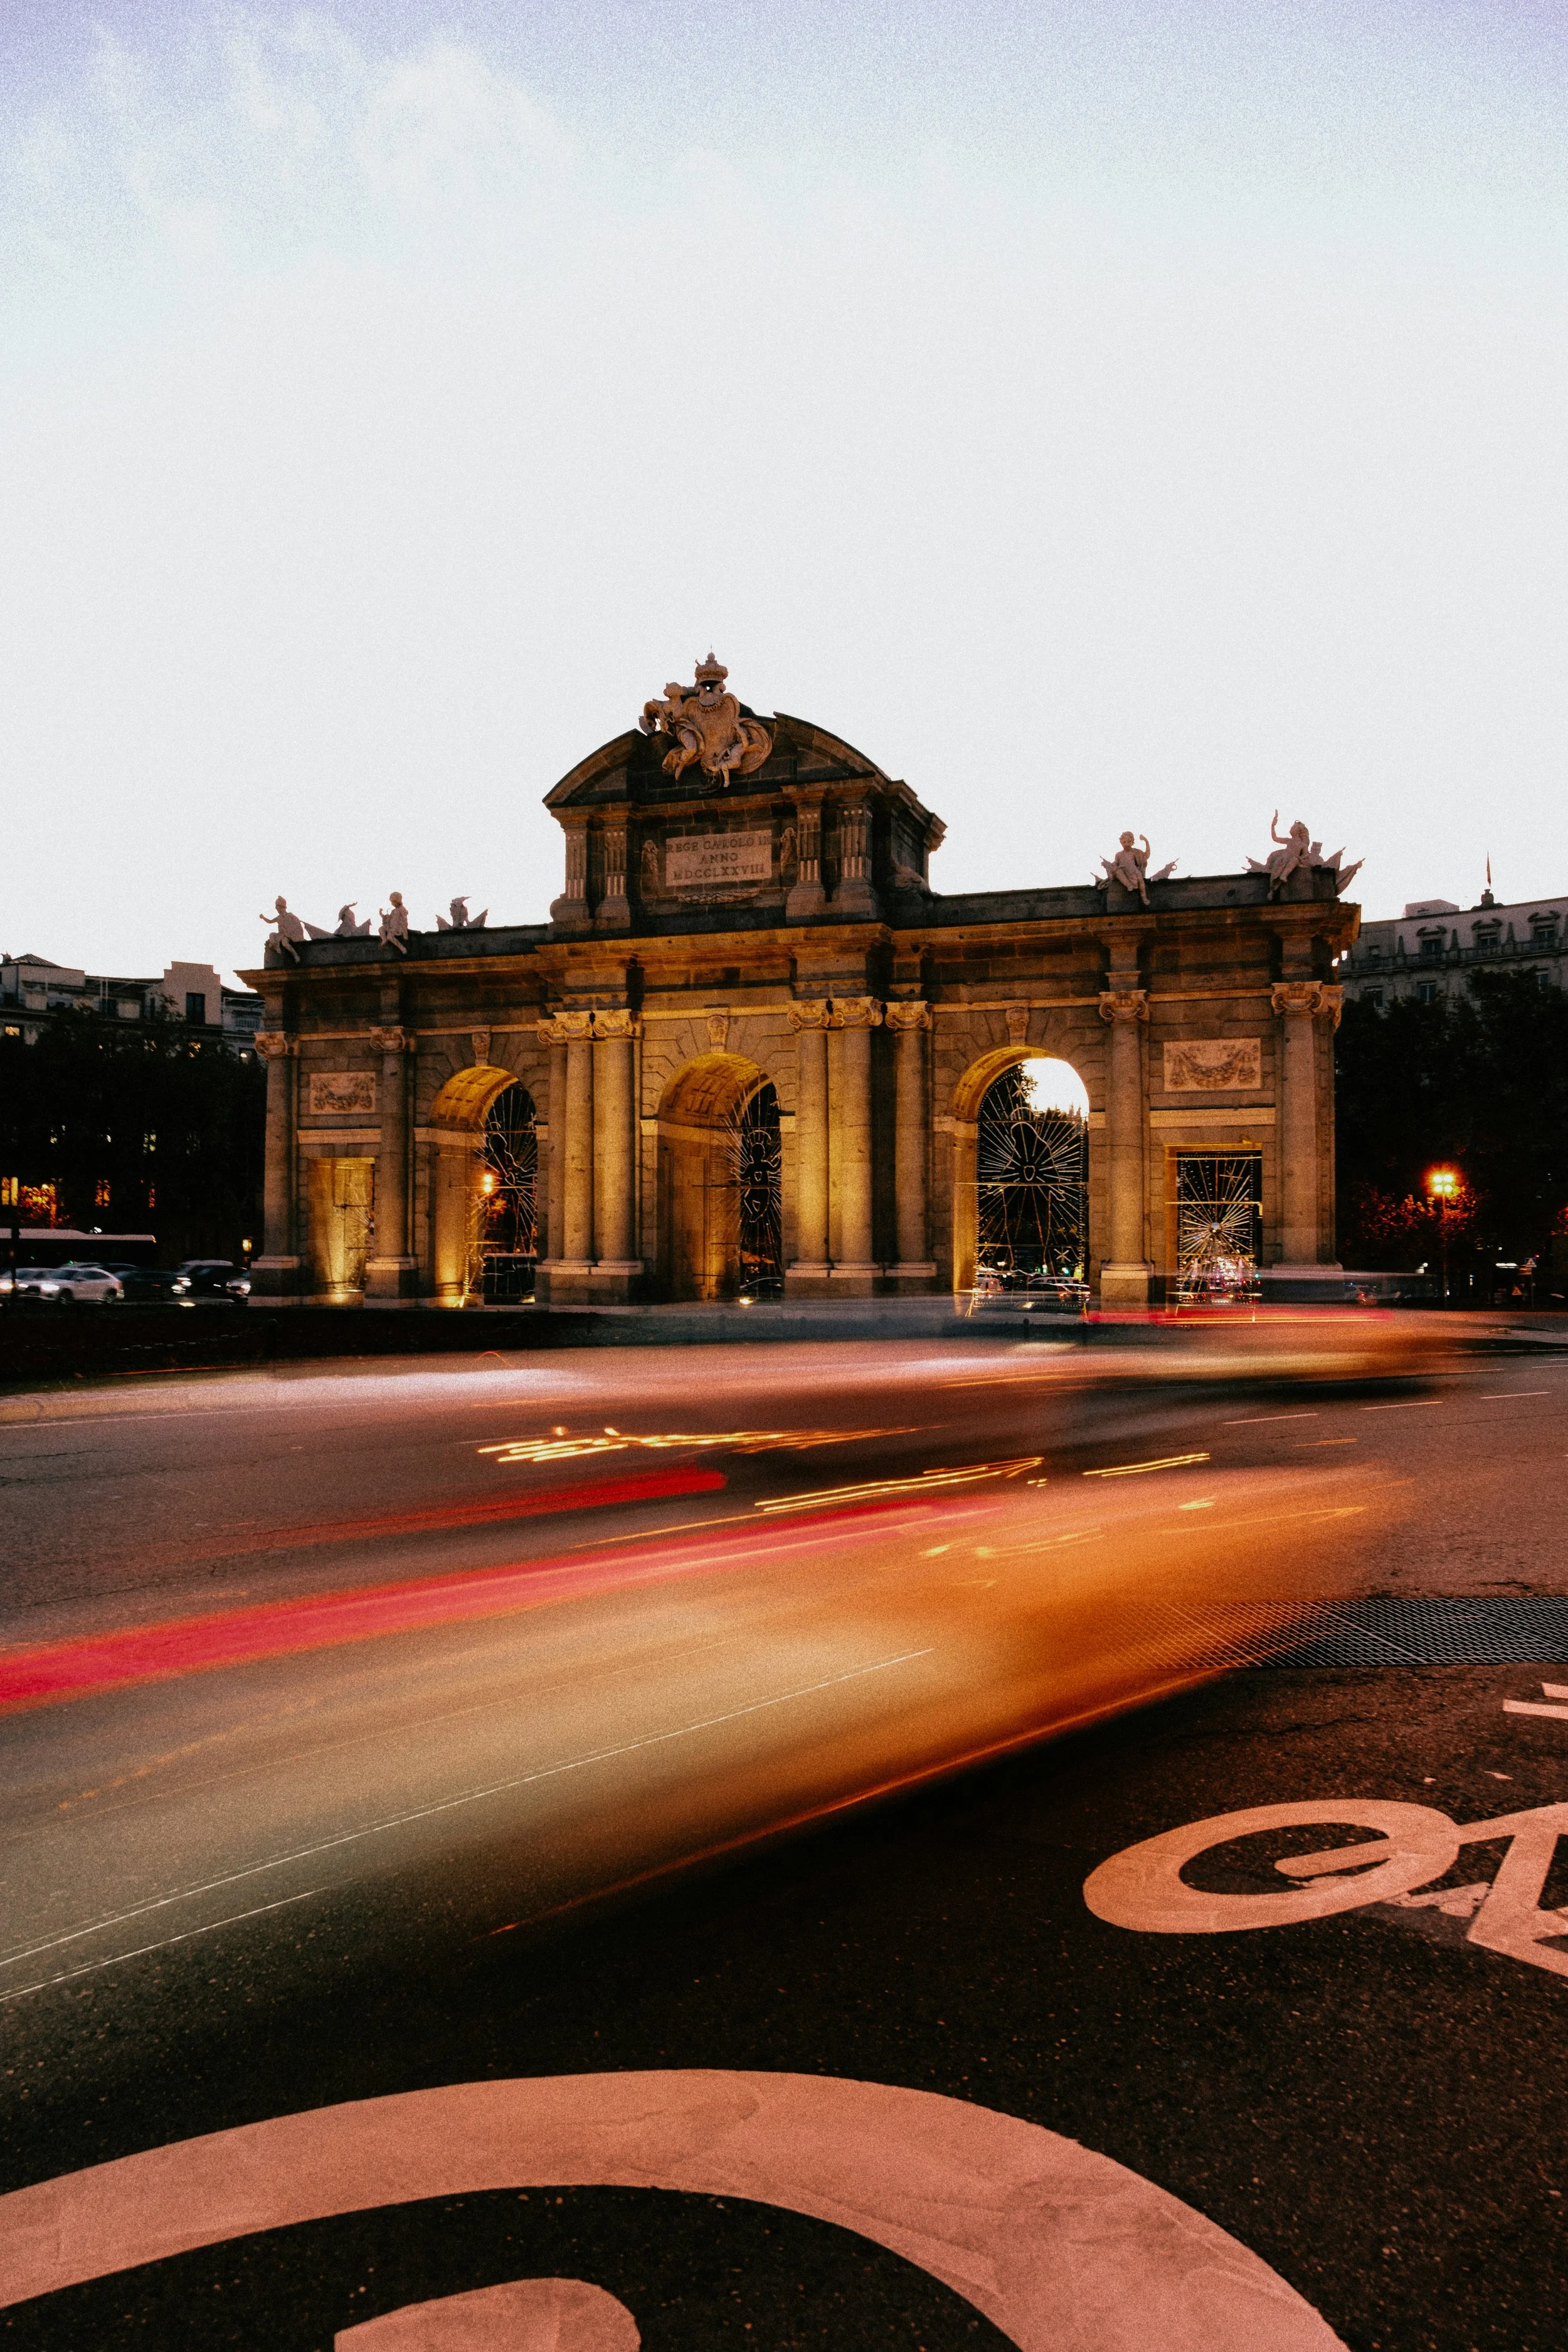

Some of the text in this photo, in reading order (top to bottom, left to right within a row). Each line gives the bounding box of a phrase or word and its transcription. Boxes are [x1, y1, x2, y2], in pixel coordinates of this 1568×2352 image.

[666, 842, 699, 852] REGE
[703, 838, 755, 850] CAROLO
[700, 852, 738, 864] ANNO
[673, 864, 765, 880] MDCCLXXVIII
